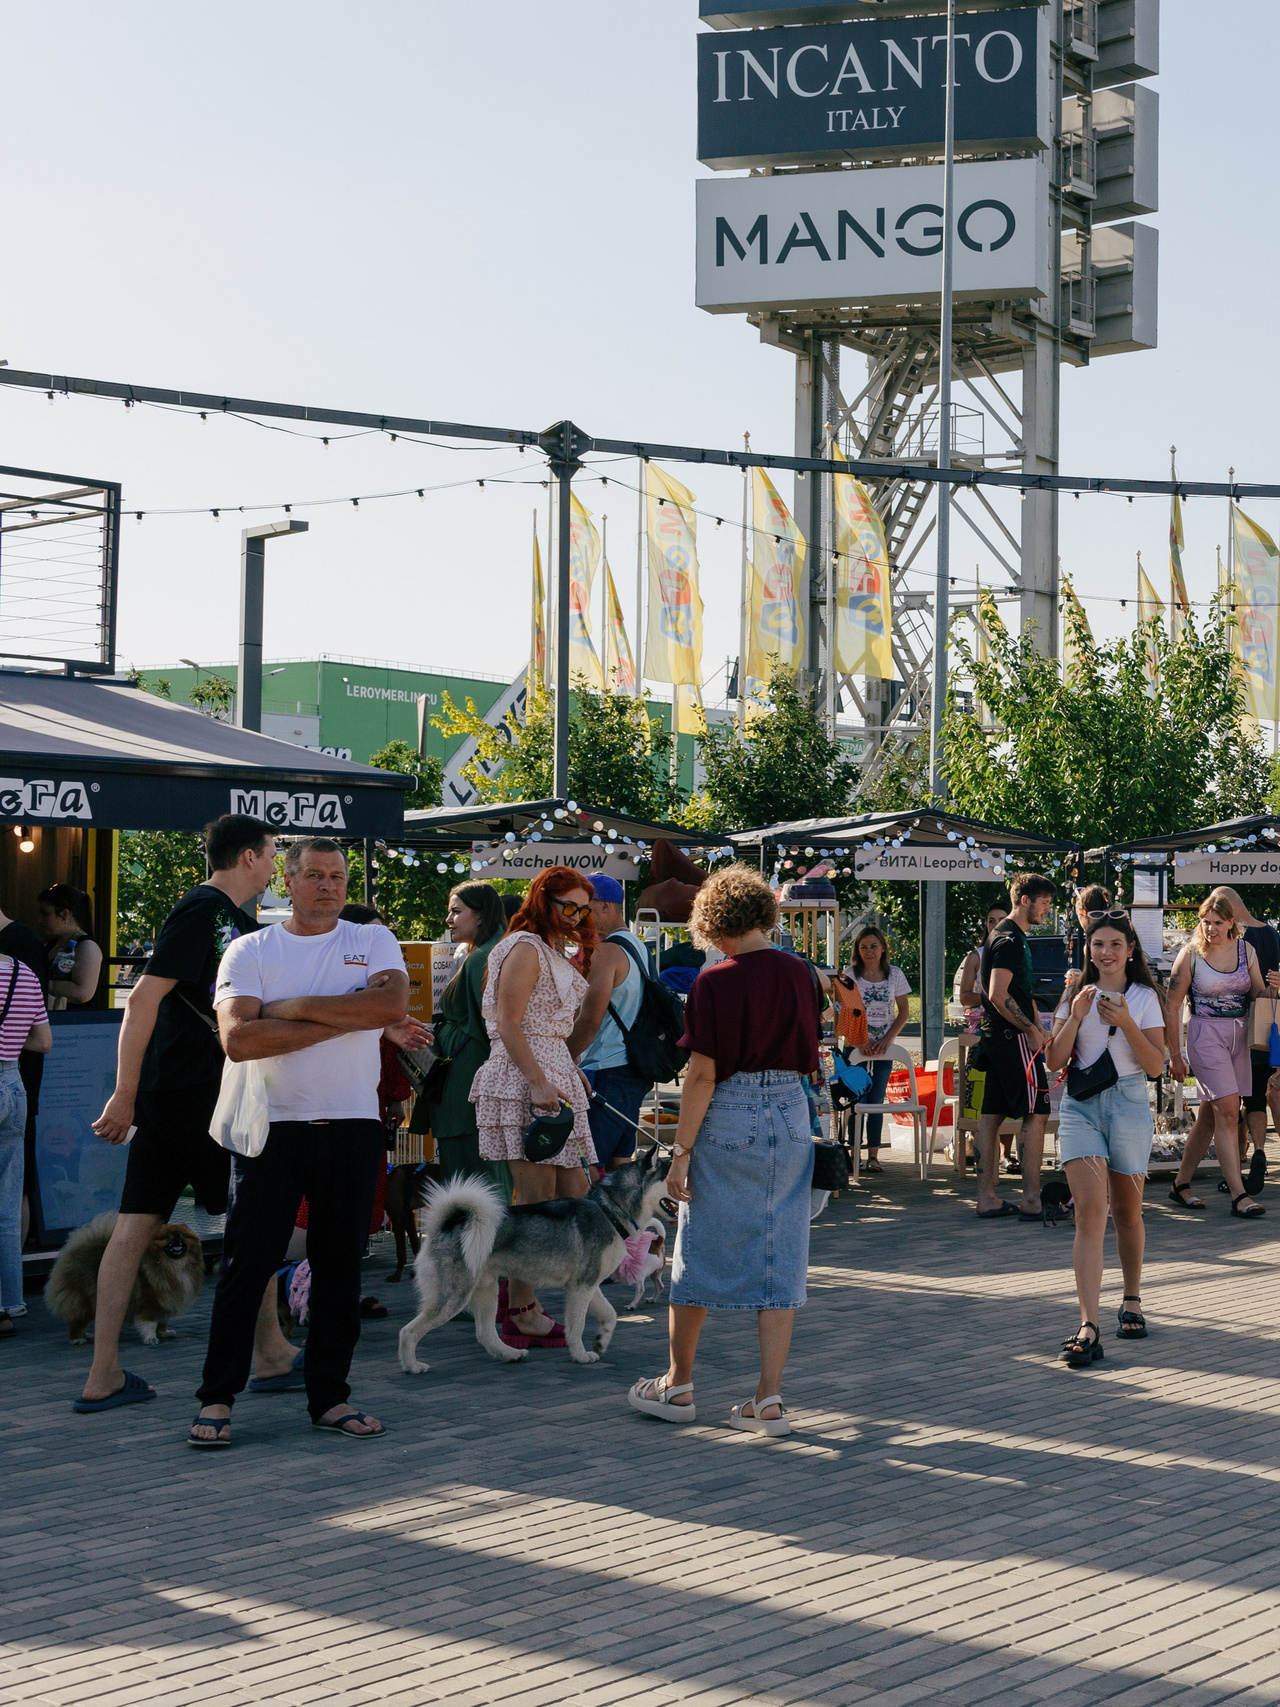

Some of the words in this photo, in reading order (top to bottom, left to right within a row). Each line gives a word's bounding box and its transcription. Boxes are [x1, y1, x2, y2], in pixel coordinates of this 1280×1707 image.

[712, 30, 1024, 103] INCANTO
[826, 106, 907, 133] ITALY
[715, 199, 1016, 267] MANGO
[502, 855, 559, 868] Rachel
[563, 855, 608, 868] WOW
[924, 856, 980, 871] Leopart
[1210, 861, 1257, 875] Happy
[344, 954, 366, 962] EA7
